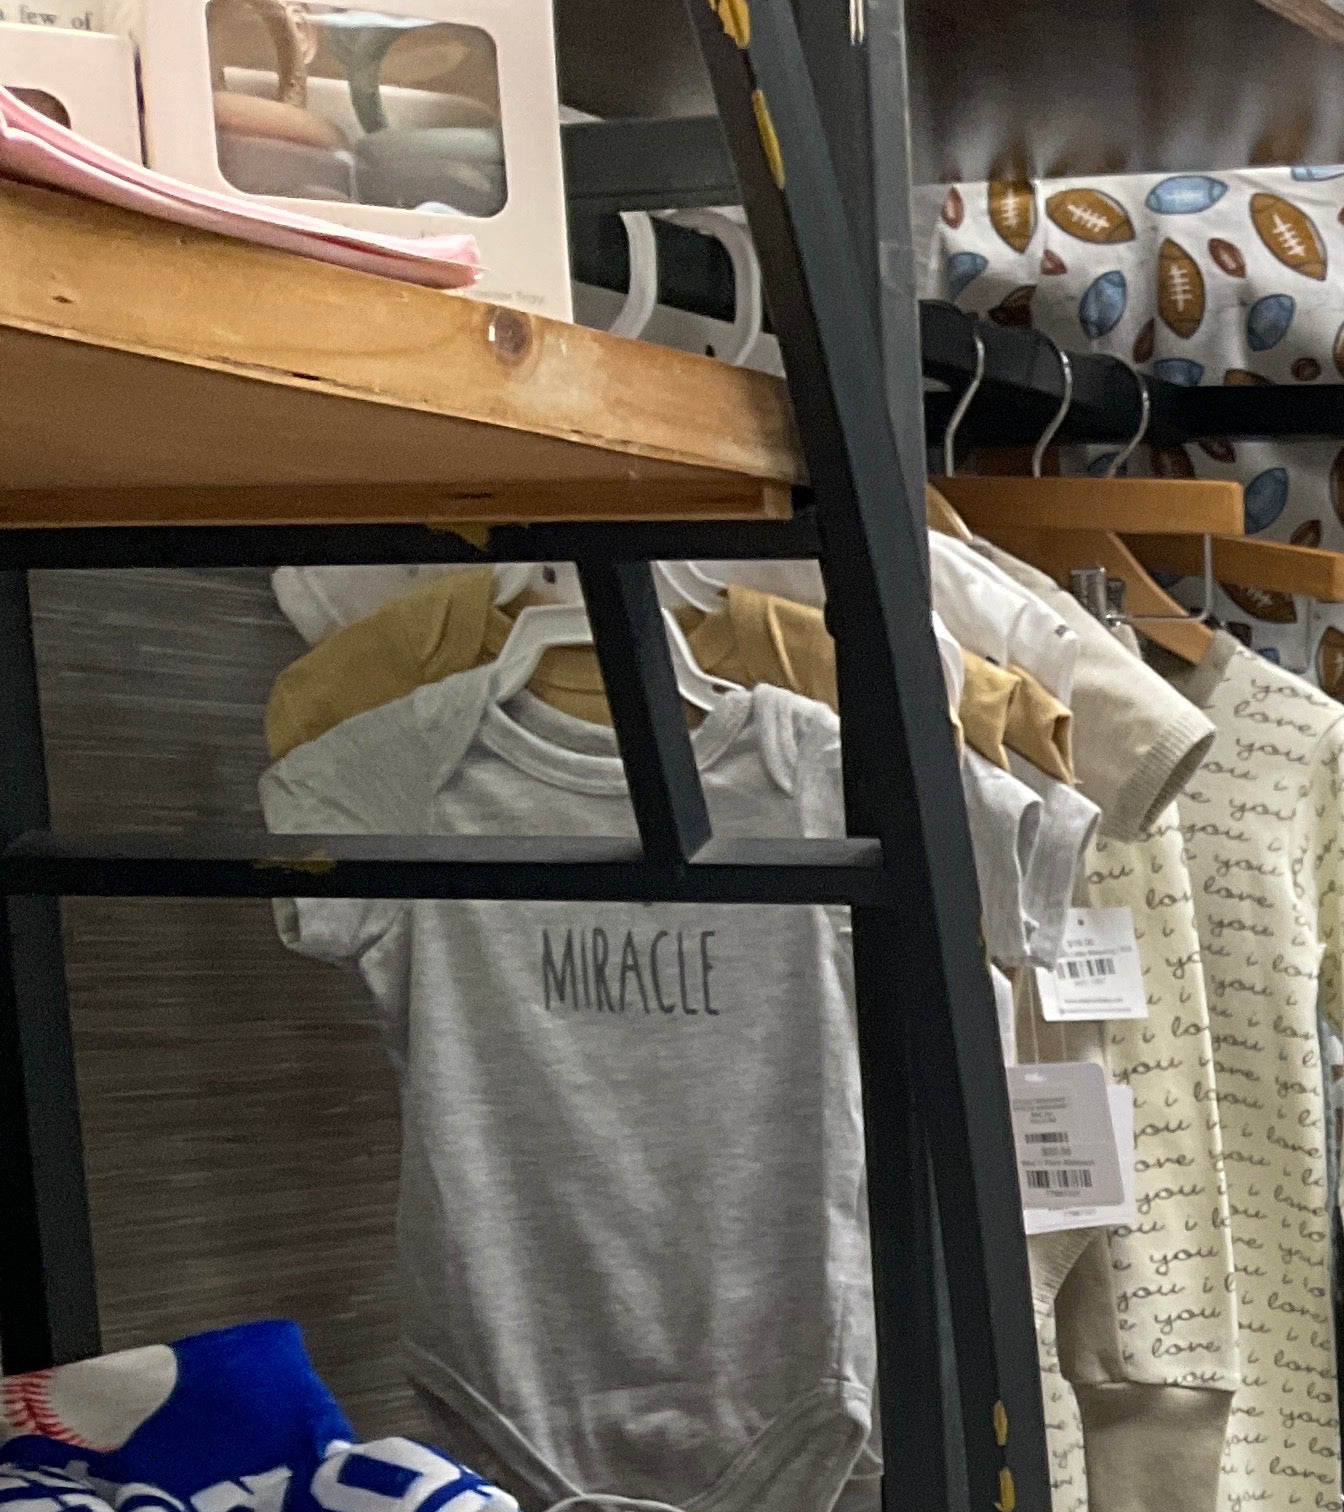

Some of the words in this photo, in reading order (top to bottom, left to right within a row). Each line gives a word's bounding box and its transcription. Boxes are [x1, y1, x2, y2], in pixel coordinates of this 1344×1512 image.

[20, 4, 57, 24] few
[71, 10, 93, 31] of
[1200, 761, 1258, 780] ou
[1087, 865, 1134, 884] ou
[1146, 889, 1192, 910] lov
[540, 926, 719, 1017] MIRACLE
[1165, 951, 1200, 980] yo
[1272, 954, 1318, 980] lov
[1213, 1062, 1261, 1082] ove
[1134, 1153, 1194, 1172] ove
